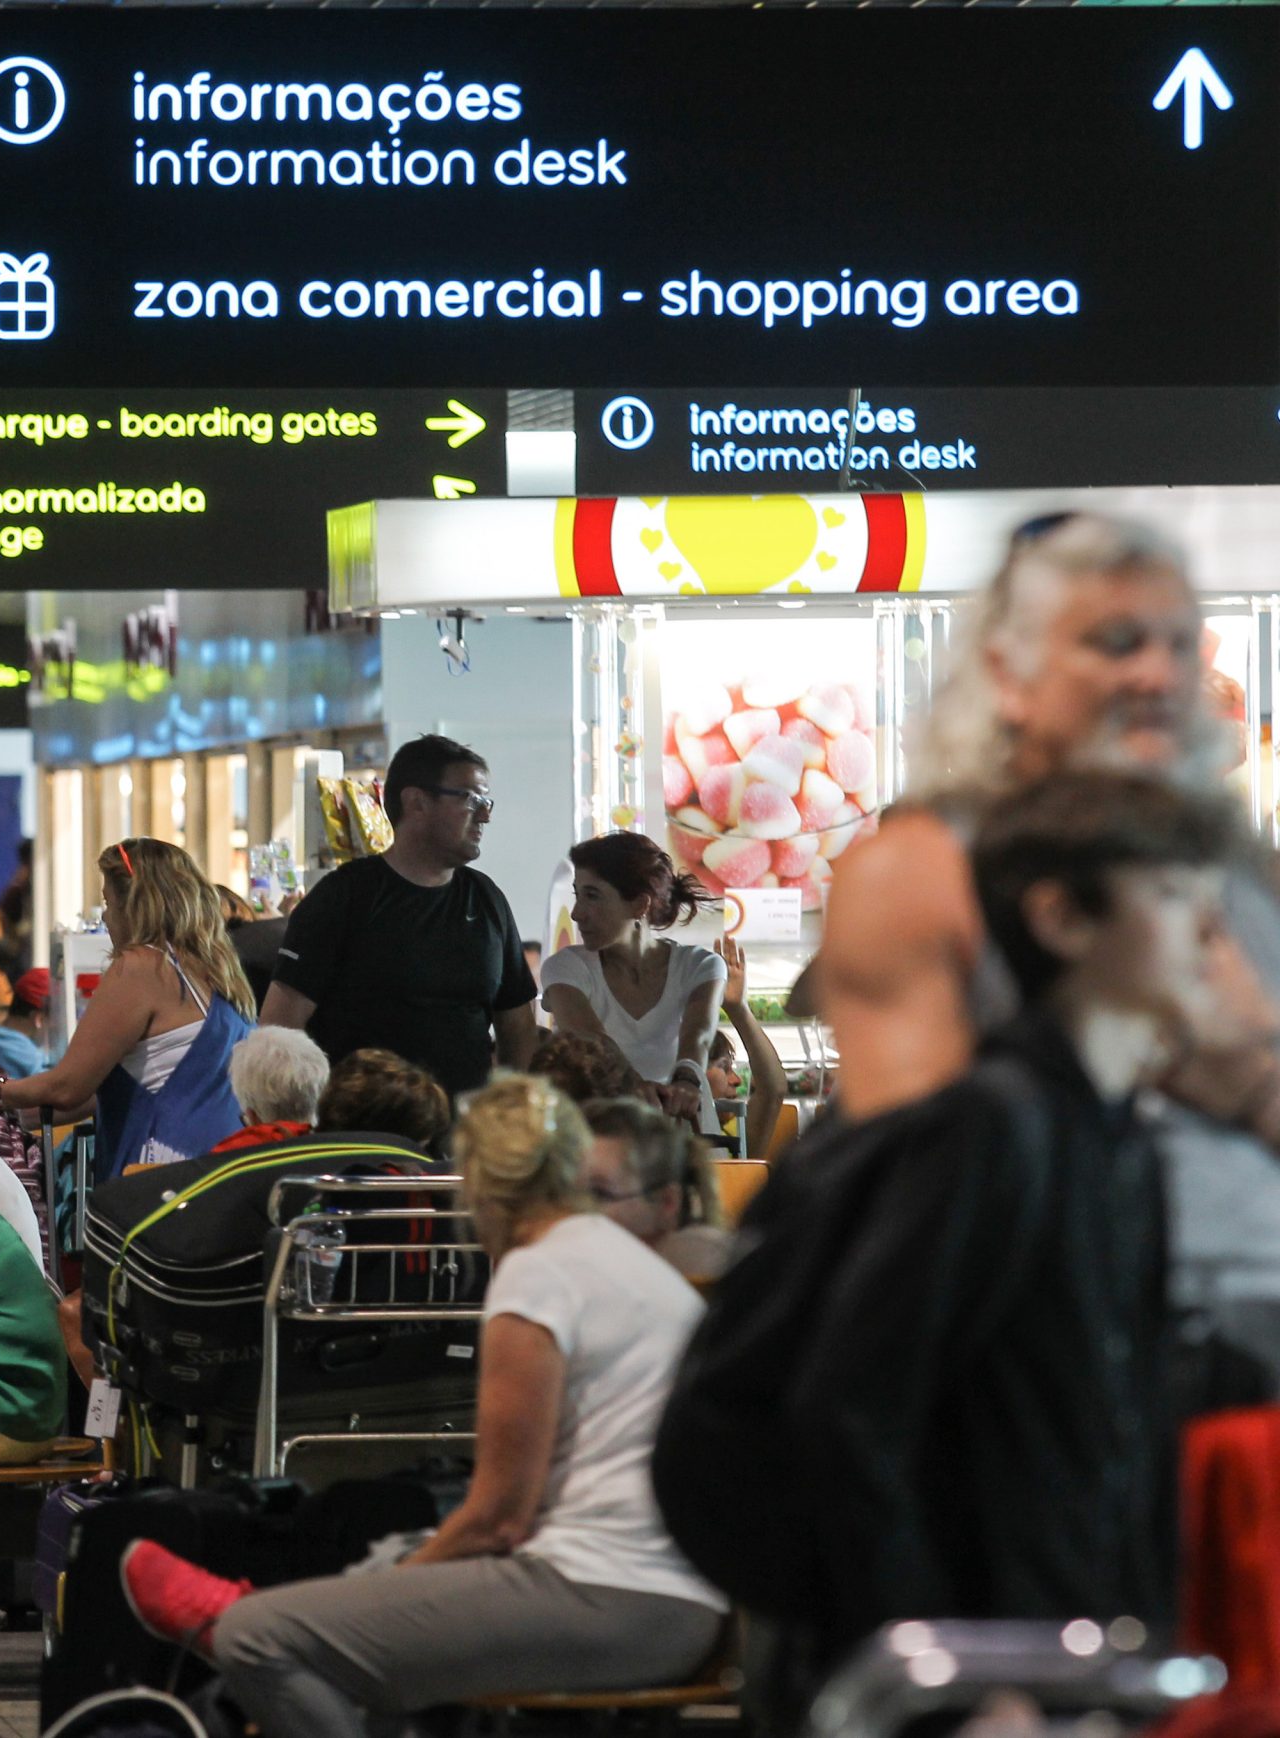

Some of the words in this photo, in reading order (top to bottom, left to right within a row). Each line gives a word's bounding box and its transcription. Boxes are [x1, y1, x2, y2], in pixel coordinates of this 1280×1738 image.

[134, 71, 522, 132] informações
[135, 138, 476, 187] information
[494, 138, 627, 187] desk
[134, 280, 279, 318] zona
[299, 268, 602, 318] comercial
[661, 268, 928, 328] shopping
[944, 279, 1079, 316] area
[120, 407, 273, 443] boarding
[281, 408, 377, 443] gates
[690, 402, 917, 439] informações
[692, 441, 889, 472] information
[898, 438, 976, 470] desk
